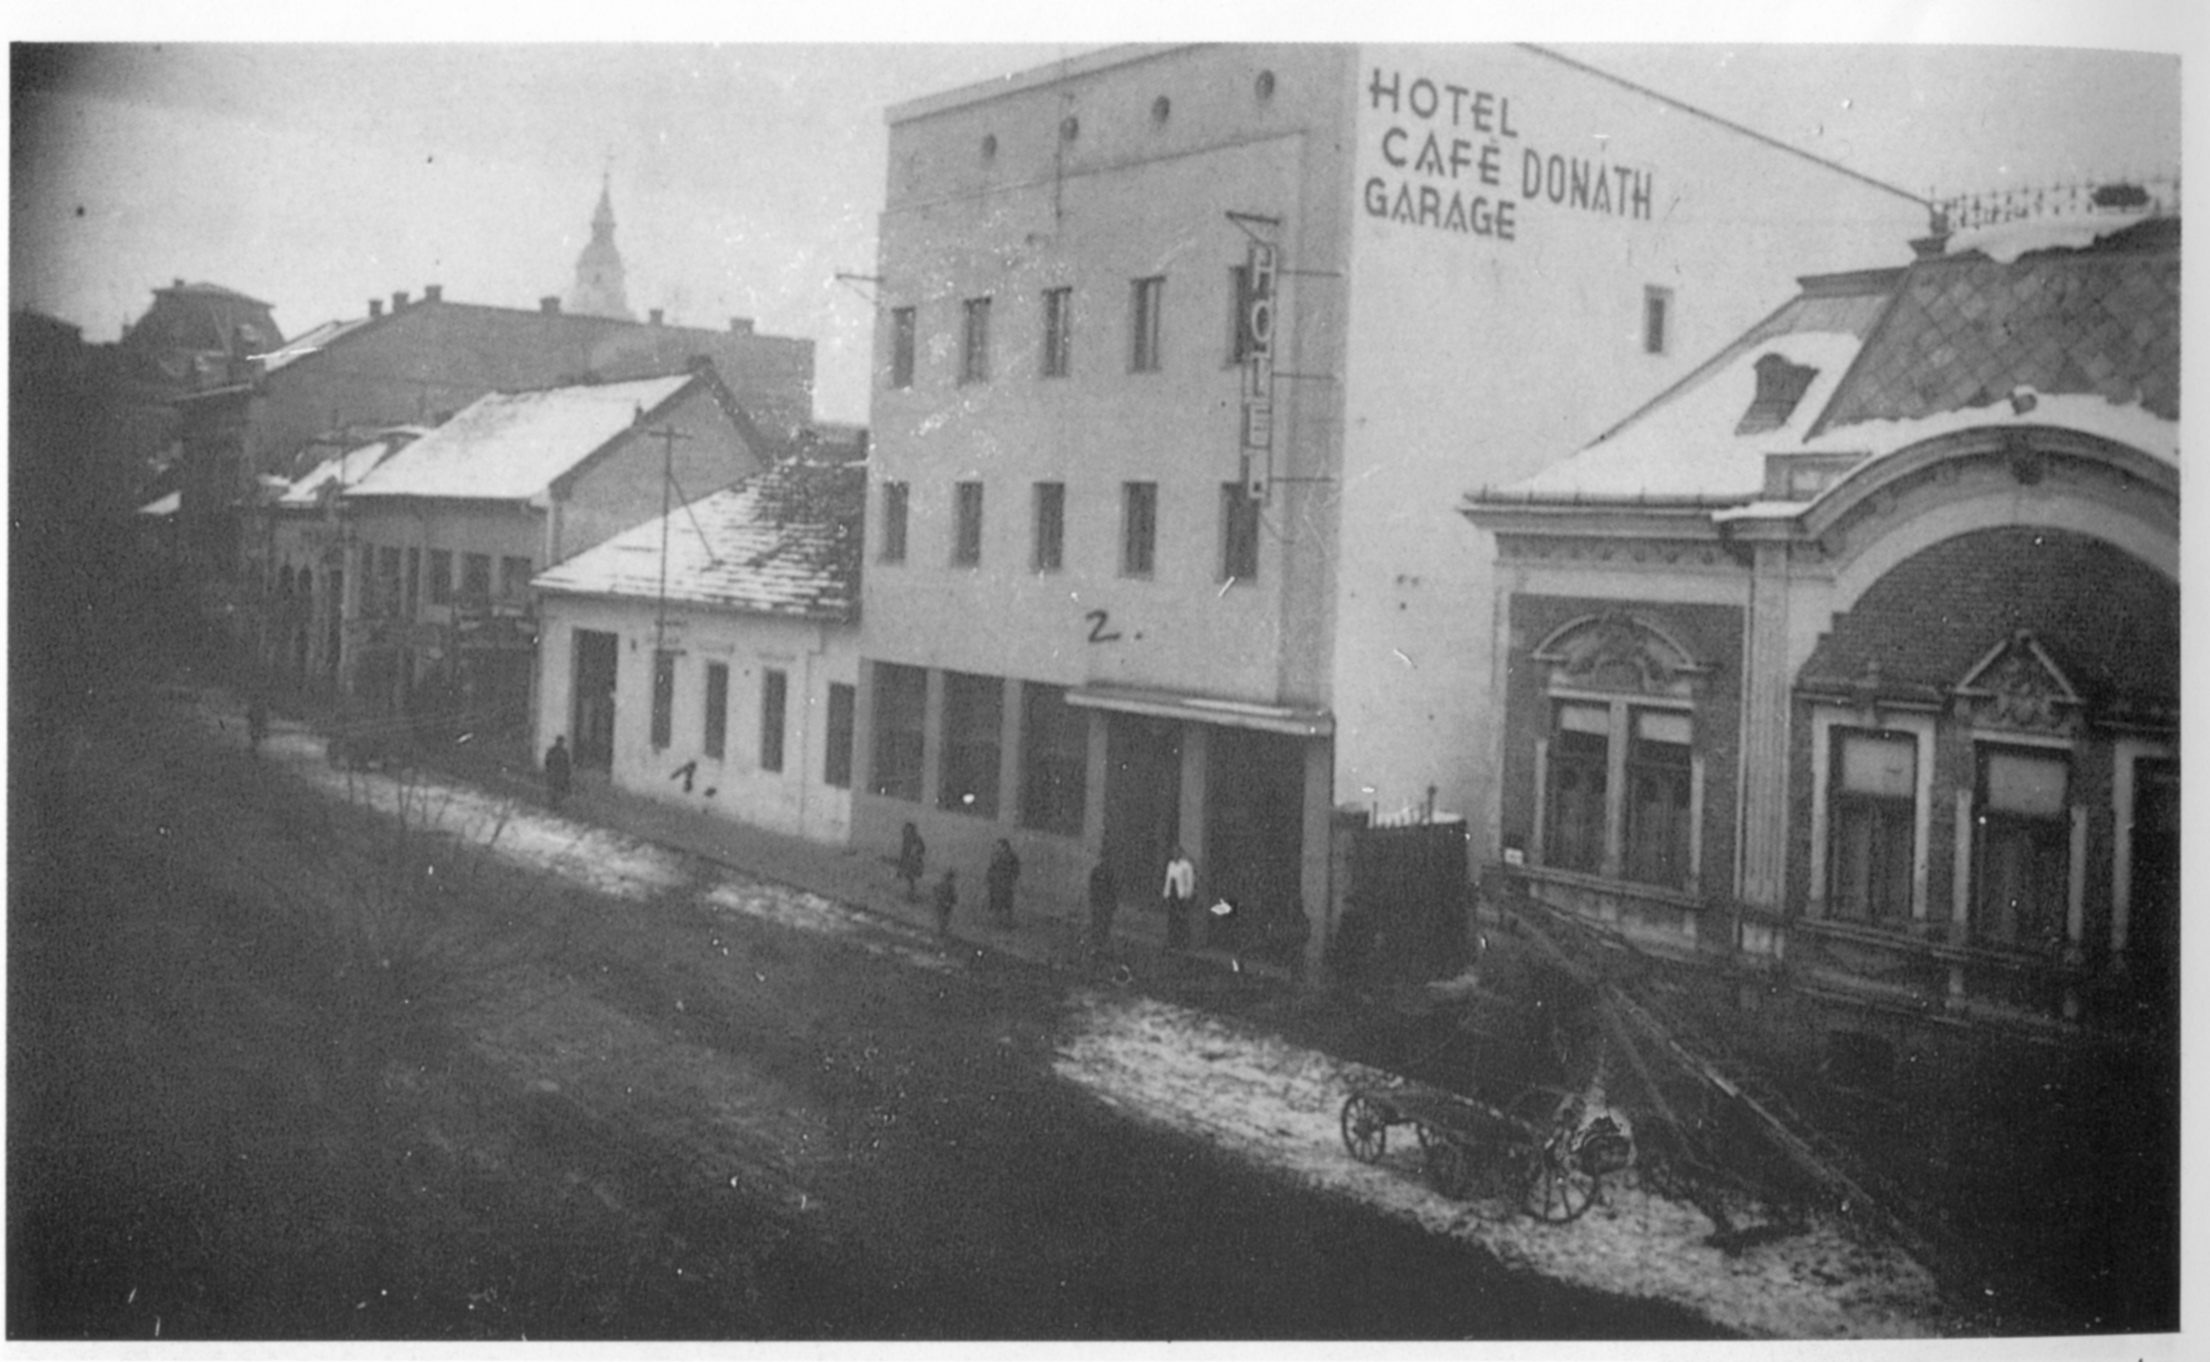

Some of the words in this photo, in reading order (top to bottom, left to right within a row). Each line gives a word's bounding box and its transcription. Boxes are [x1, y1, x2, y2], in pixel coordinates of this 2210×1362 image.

[1369, 67, 1517, 138] HOTEL
[1364, 177, 1516, 241] GARAGE
[1248, 246, 1274, 500] HOTEL
